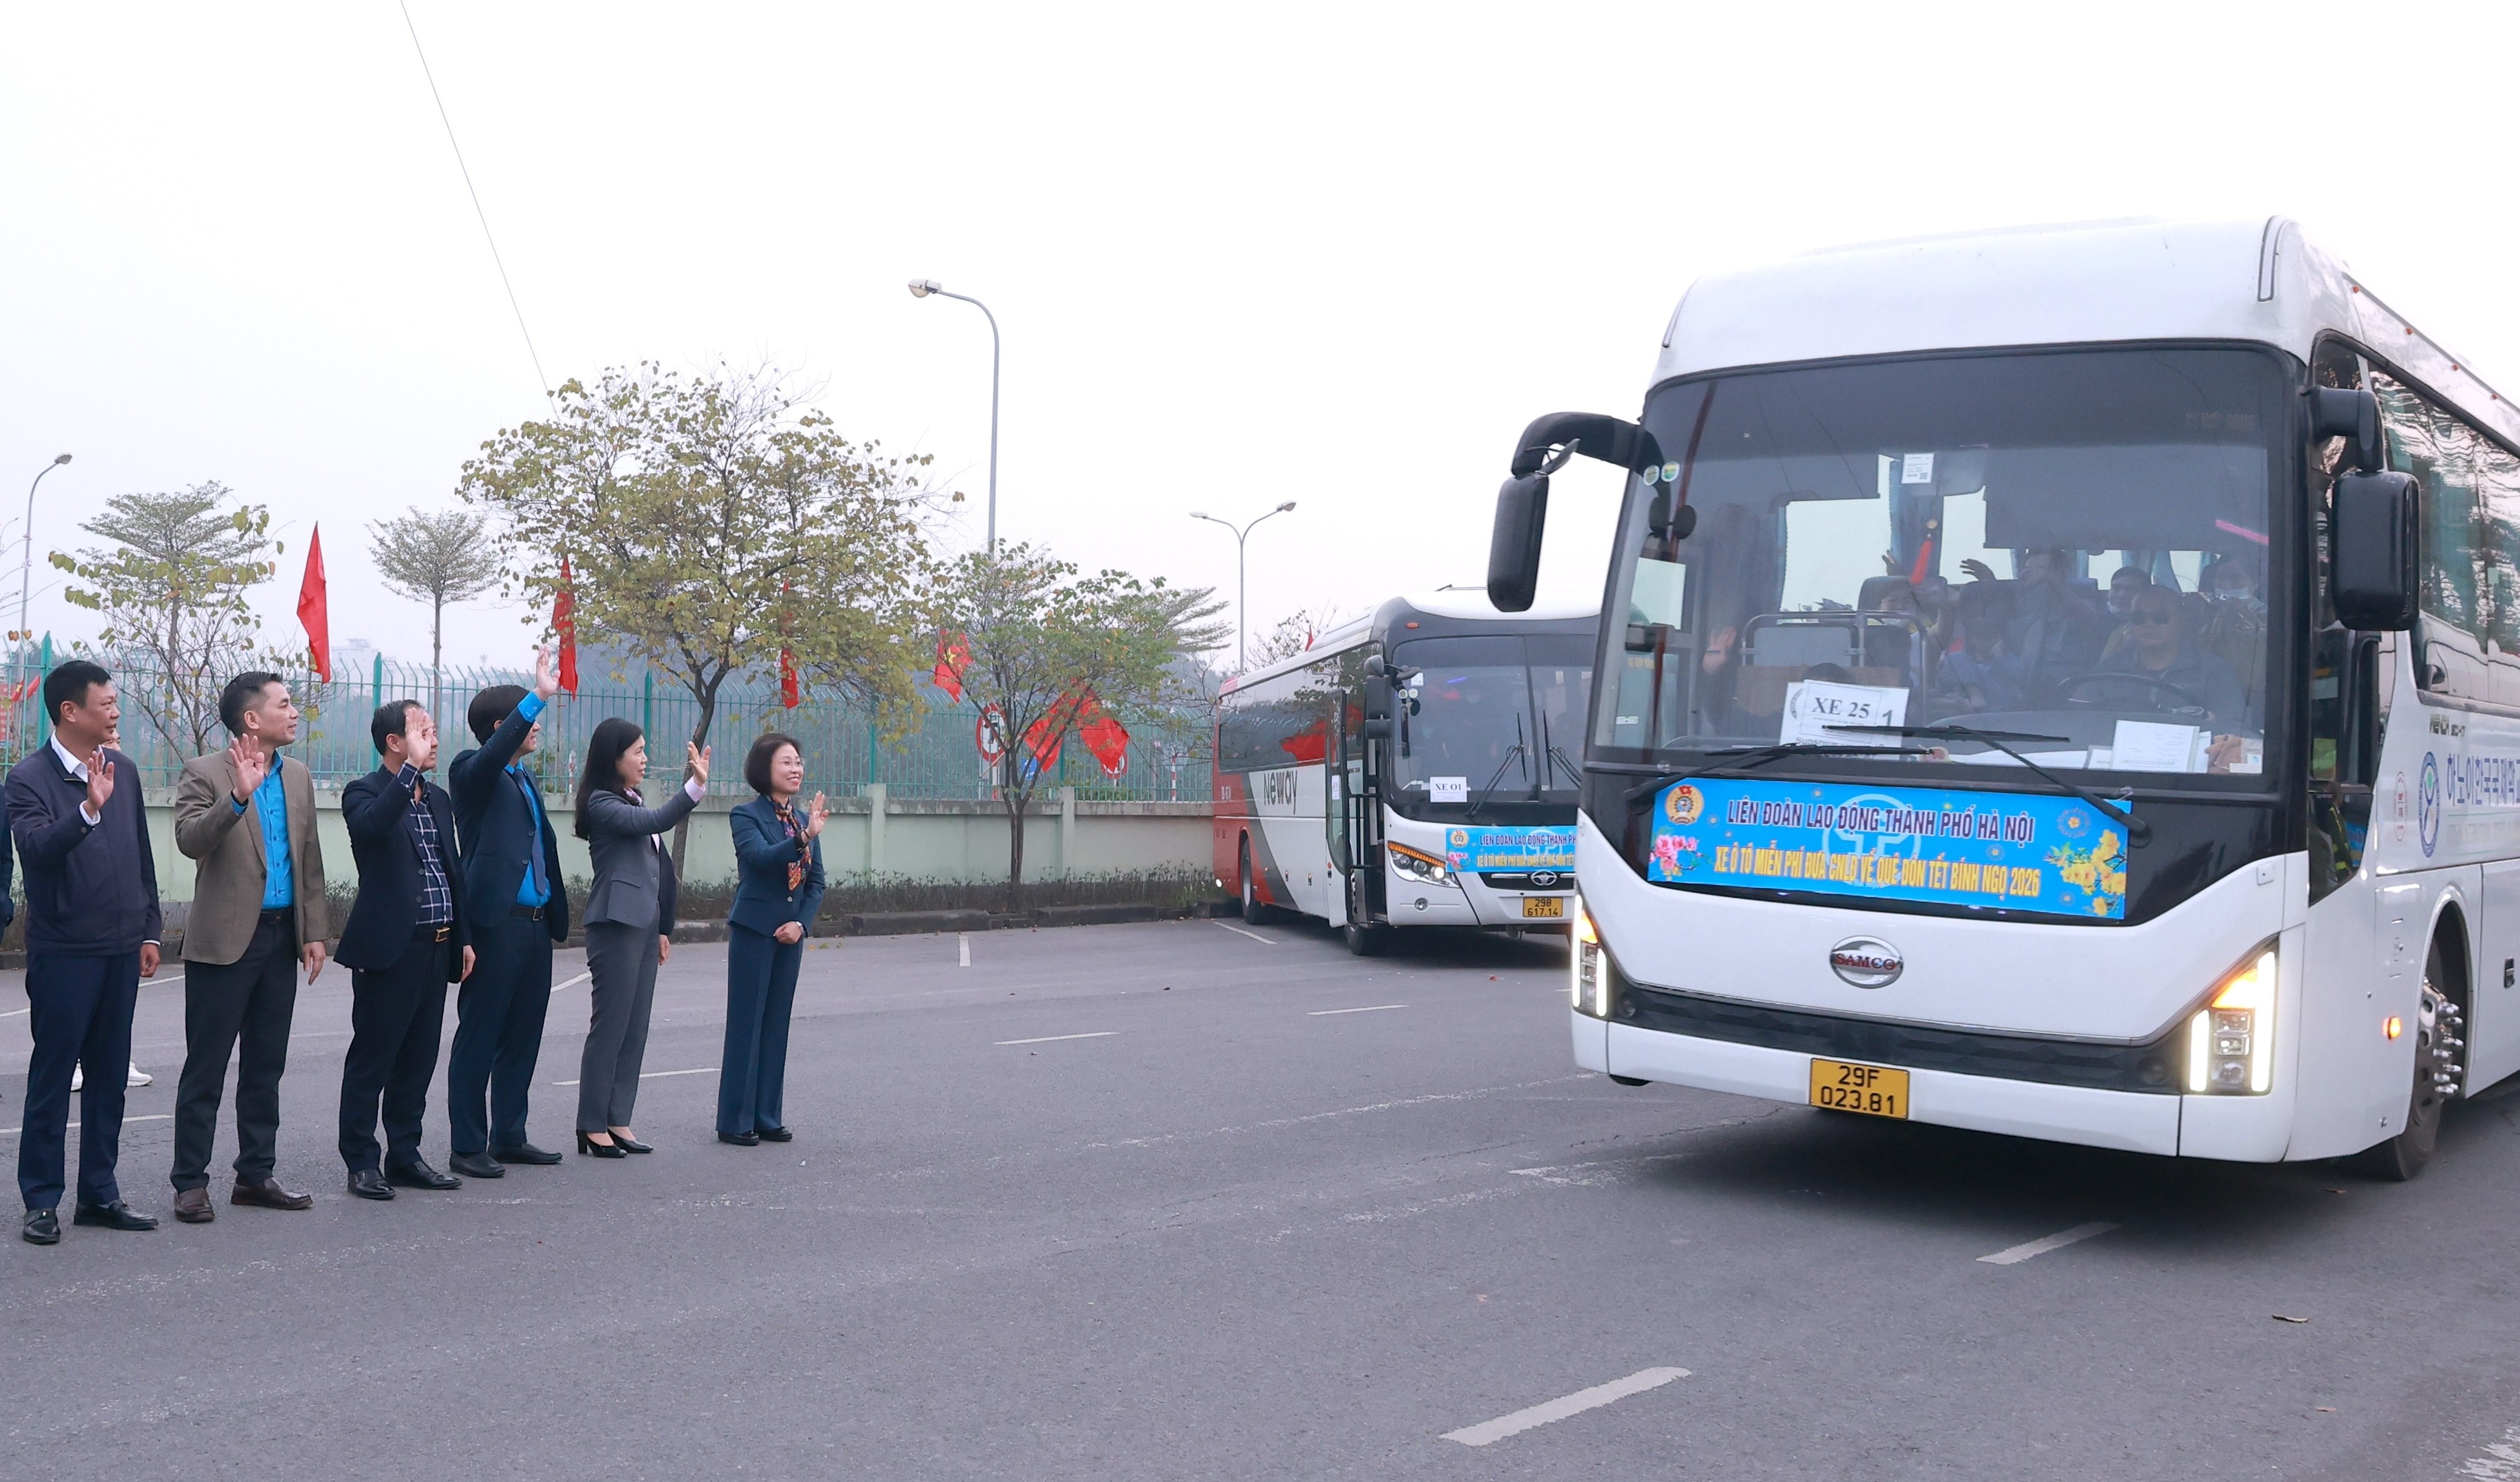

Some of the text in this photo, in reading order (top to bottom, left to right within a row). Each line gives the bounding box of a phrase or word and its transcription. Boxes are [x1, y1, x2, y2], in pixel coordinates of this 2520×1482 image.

[1811, 697, 1842, 715] XE
[1847, 702, 1871, 719] 25
[1728, 796, 2034, 848] LIÊN ĐOÀN LAO ĐỘNG THÀNH PHỐ HÀ NỘI
[1715, 839, 2041, 900] XE Ô TÔ MIỄN PHÍ ĐƯA CNLĐ VỀ QUÊ ĐÓN TẾT BÍNH NGỌ 2026
[1527, 908, 1558, 916] 617.14
[1535, 898, 1552, 907] 29B
[1836, 953, 1896, 970] SAMCO
[1839, 1065, 1880, 1088] 29F
[1821, 1085, 1895, 1114] 023.81
